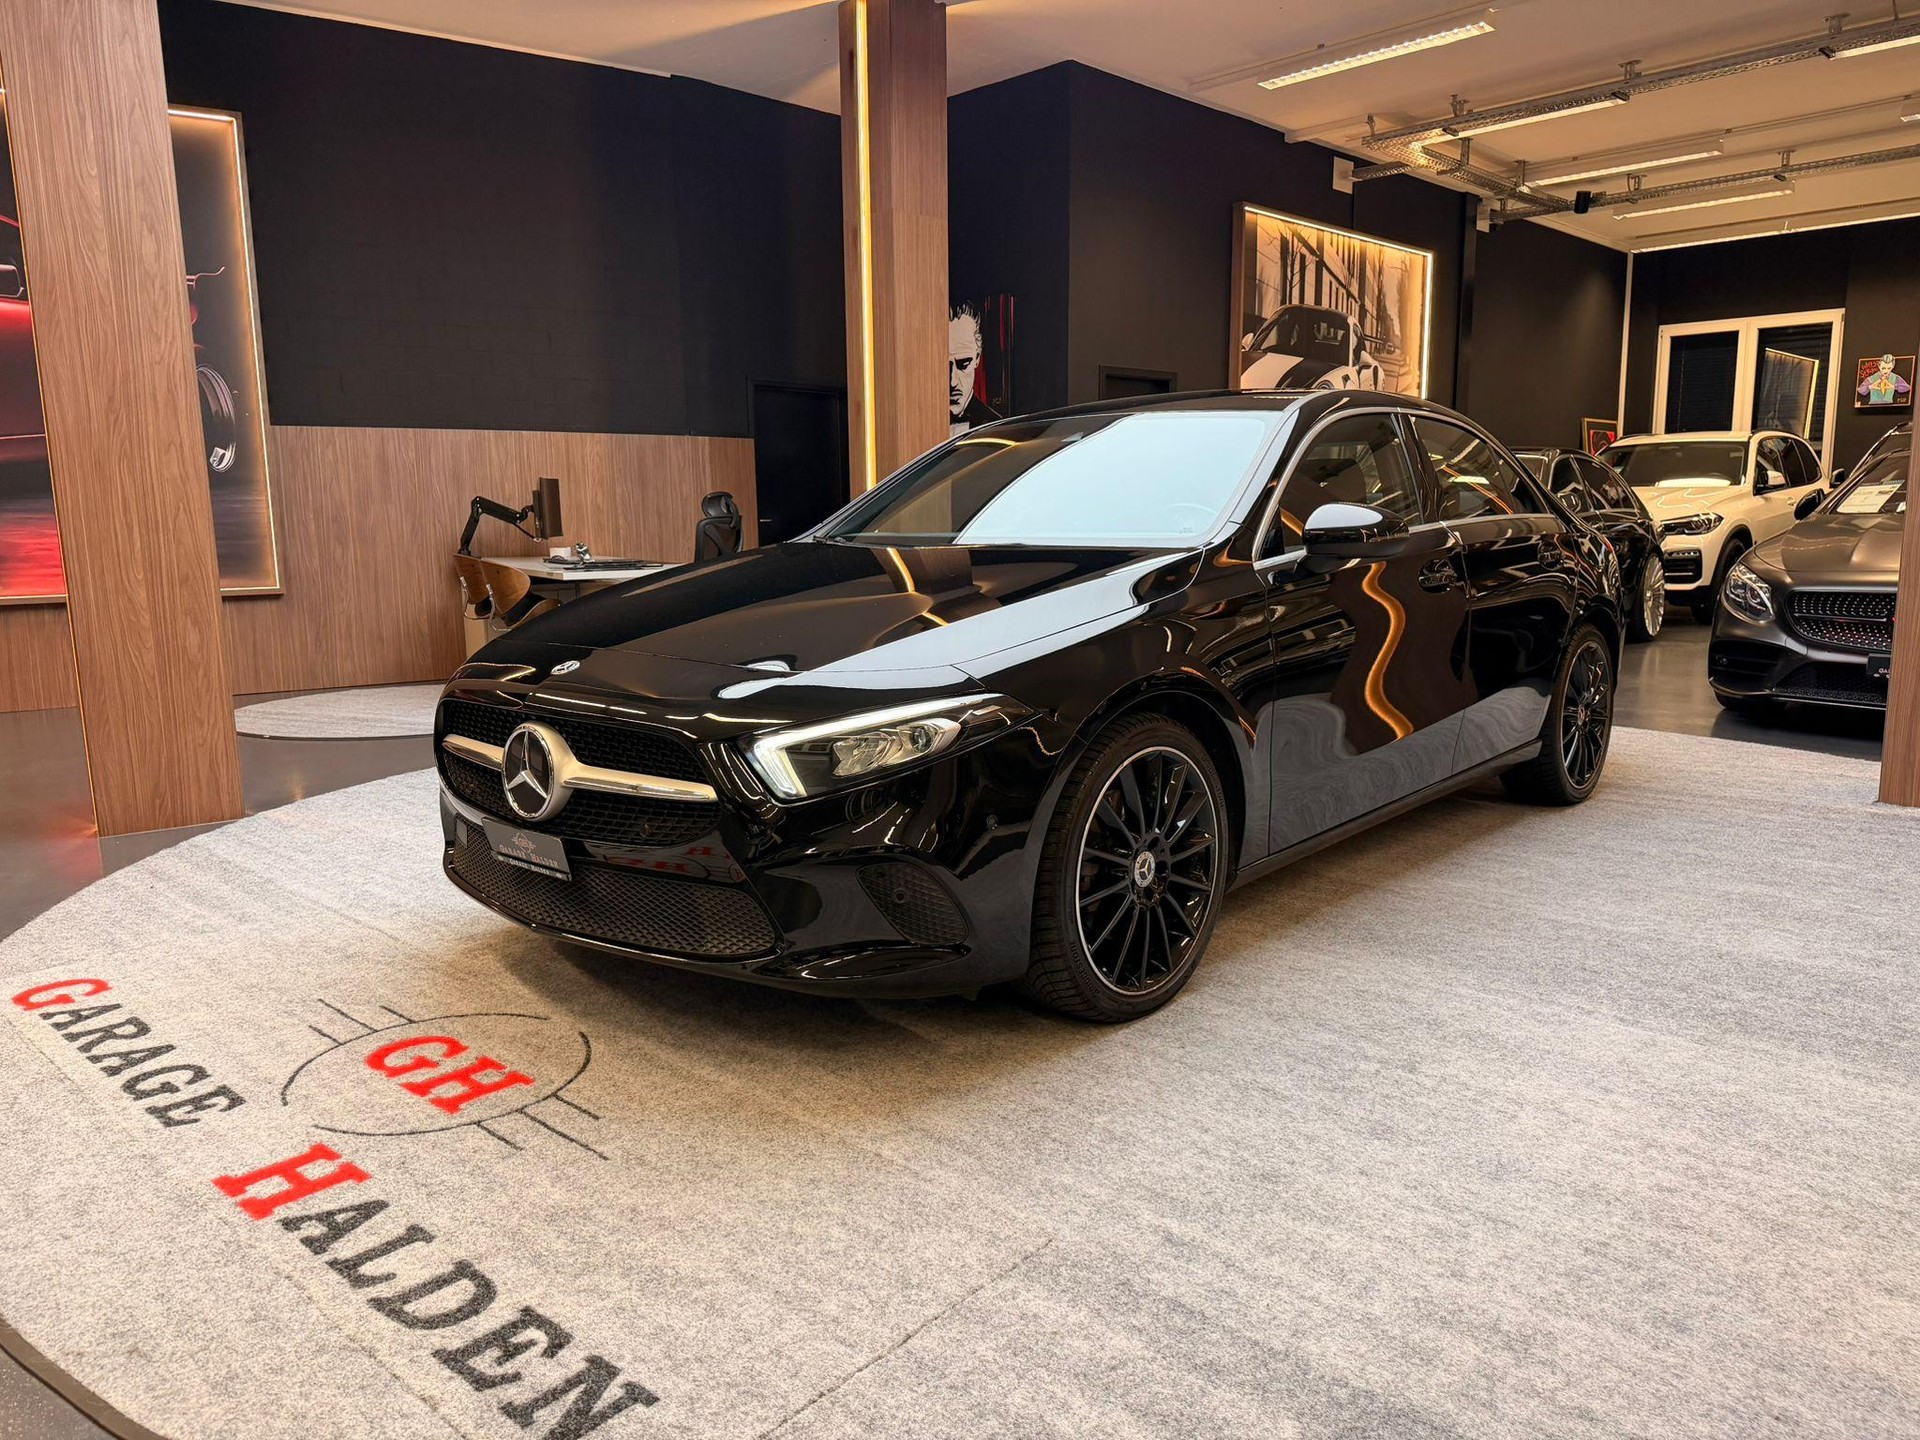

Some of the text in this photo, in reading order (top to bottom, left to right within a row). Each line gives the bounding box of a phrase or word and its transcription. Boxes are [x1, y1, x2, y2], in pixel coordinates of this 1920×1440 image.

[11, 976, 660, 1440] GARAGE HALDEN
[365, 1034, 534, 1115] GH
